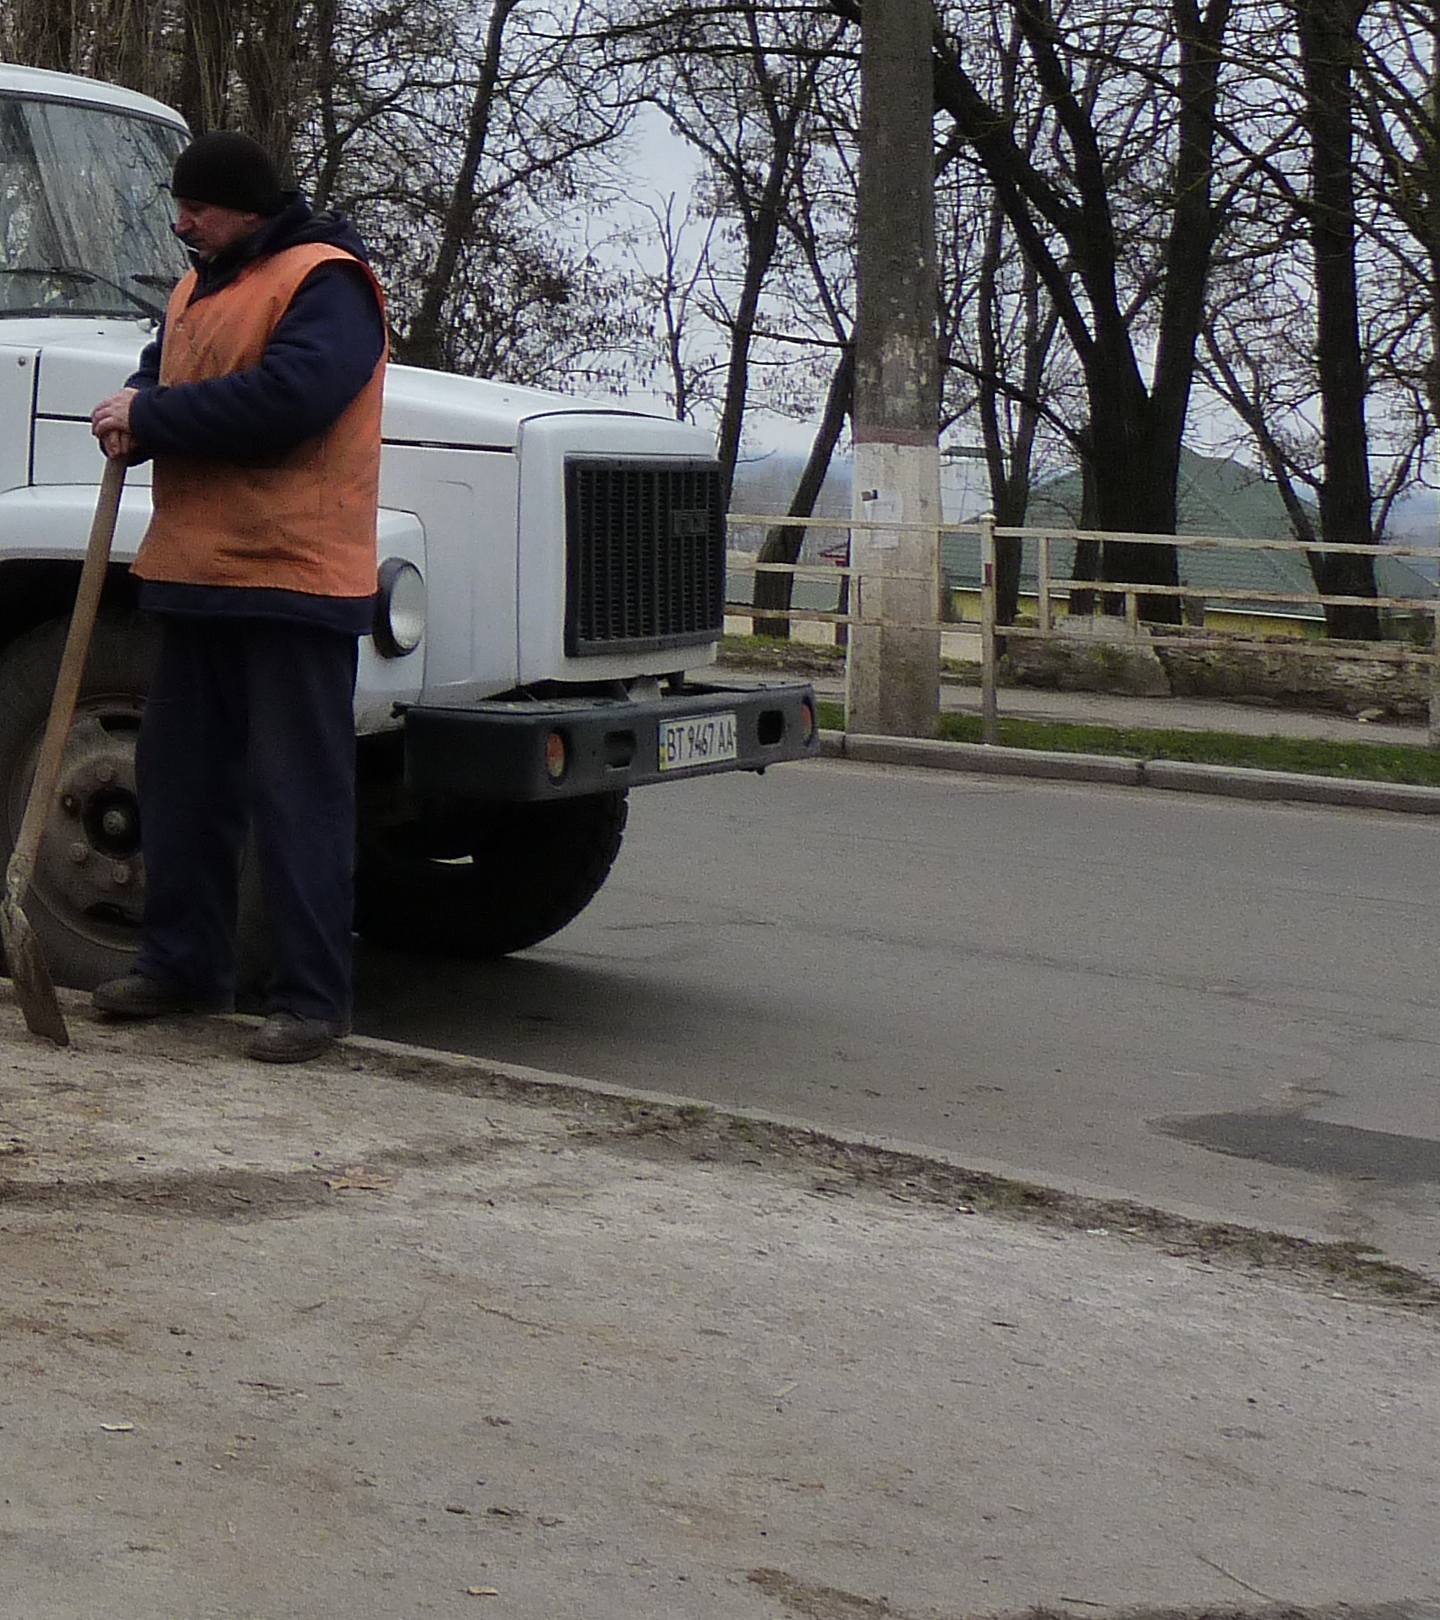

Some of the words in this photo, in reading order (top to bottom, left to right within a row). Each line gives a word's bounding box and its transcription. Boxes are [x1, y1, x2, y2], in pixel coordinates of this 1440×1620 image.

[667, 727, 685, 761] BT
[688, 723, 715, 759] 9467
[718, 721, 734, 754] AA
